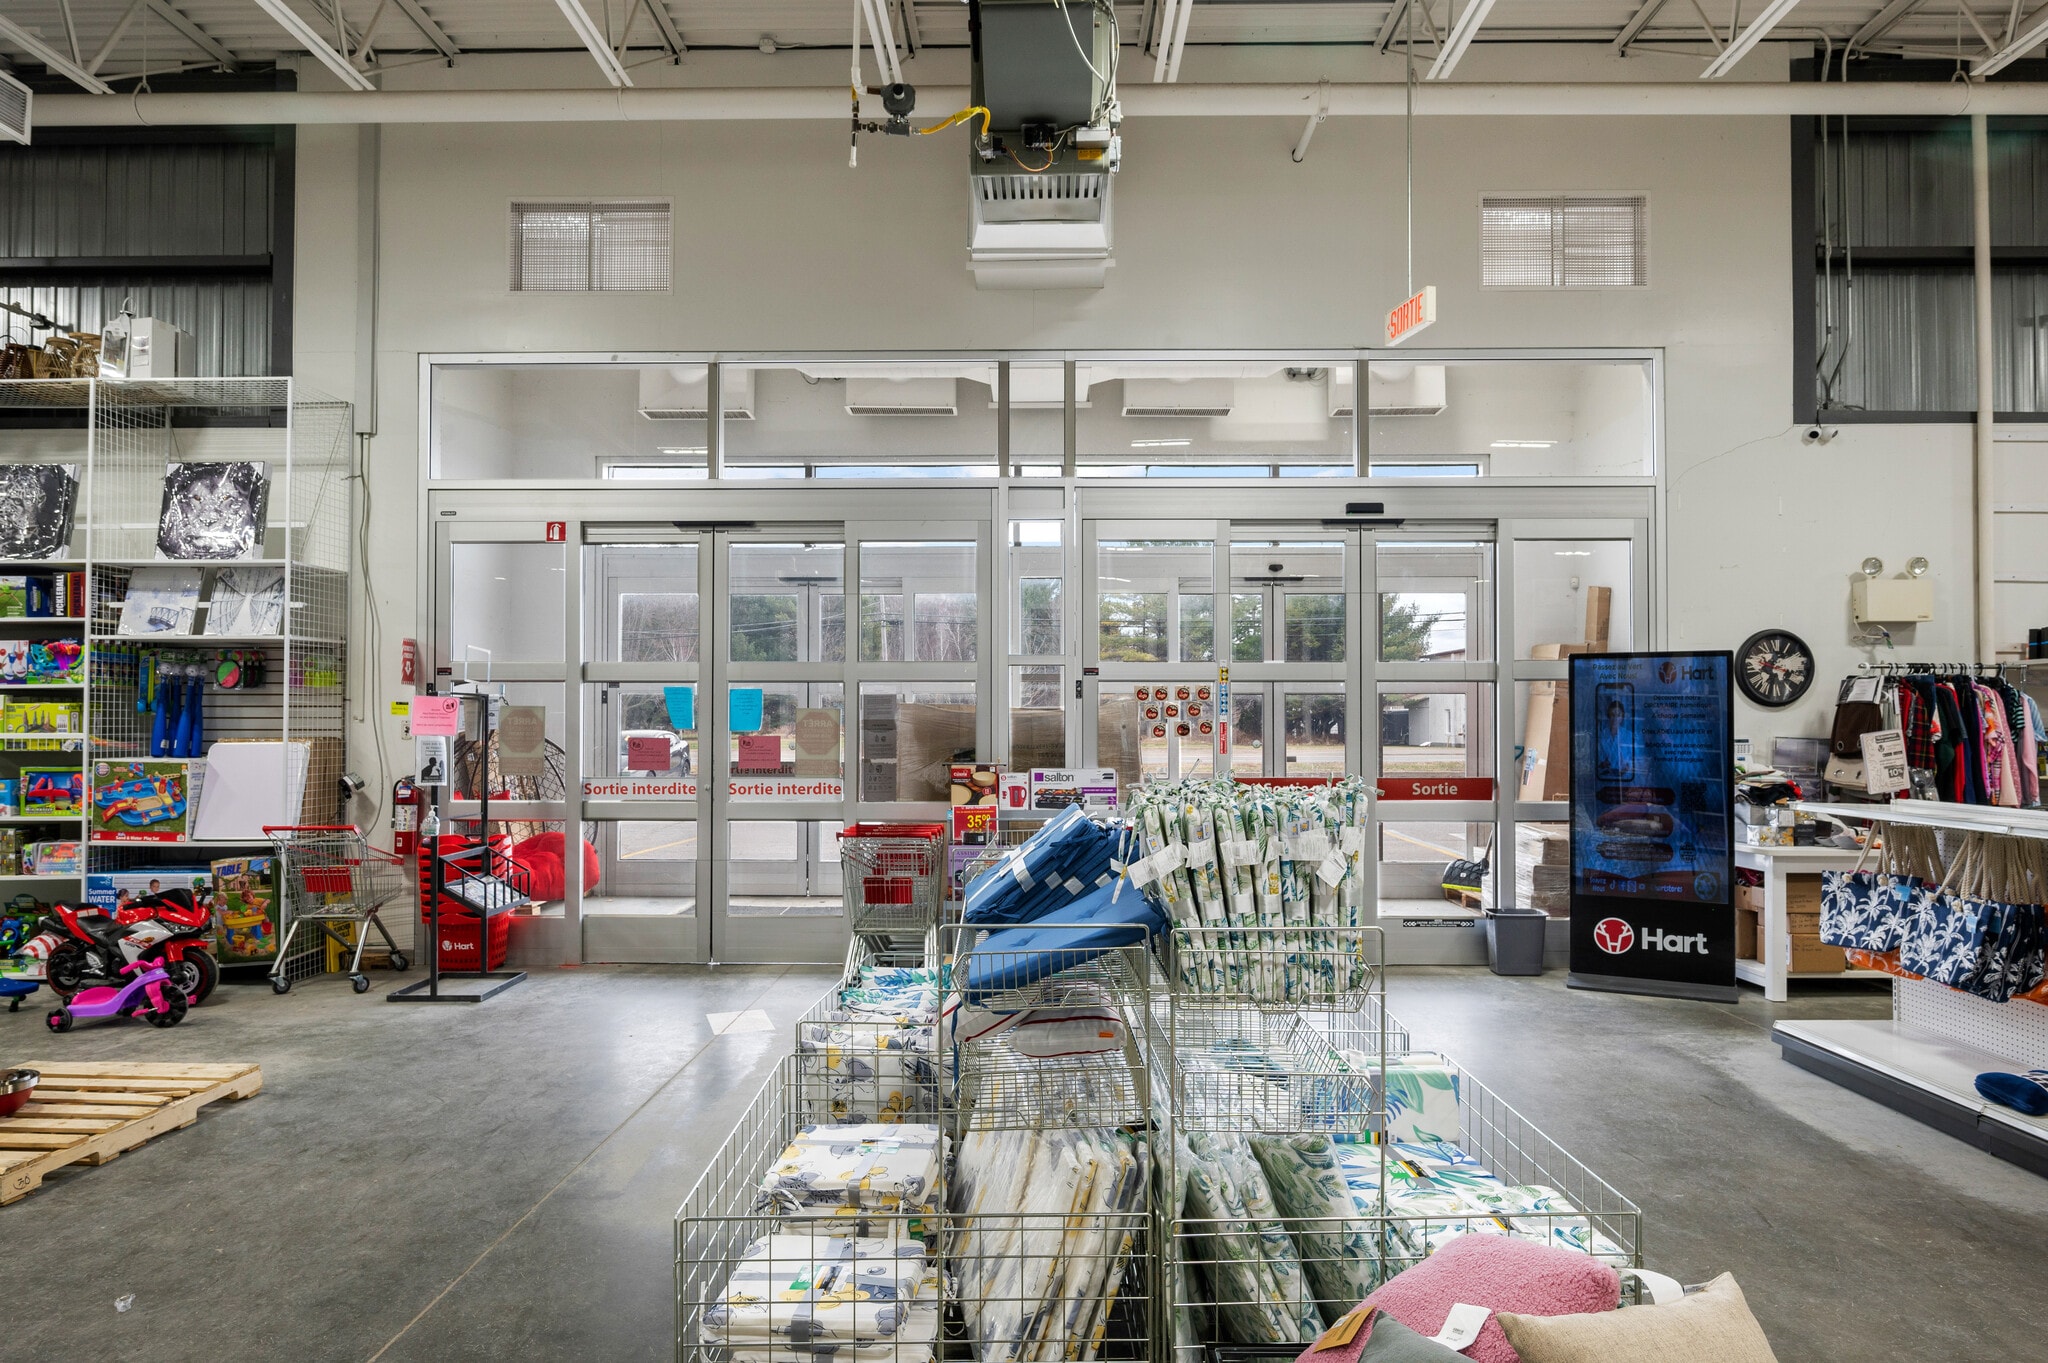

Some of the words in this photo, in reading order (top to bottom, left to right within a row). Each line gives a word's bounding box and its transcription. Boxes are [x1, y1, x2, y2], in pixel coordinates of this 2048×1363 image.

[1390, 291, 1424, 339] SORTIE
[55, 574, 65, 616] PICKLEBALL
[1681, 665, 1714, 681] Hart
[752, 766, 793, 774] interdit
[1044, 772, 1075, 782] salton
[584, 782, 629, 795] Sortie
[632, 782, 697, 795] interdite
[729, 782, 773, 795] Sortie
[777, 782, 842, 795] interdite
[1412, 782, 1458, 795] Sortie
[215, 863, 243, 877] TABLE
[88, 895, 116, 904] WATER
[453, 942, 475, 950] Hart
[1641, 927, 1709, 955] Hart
